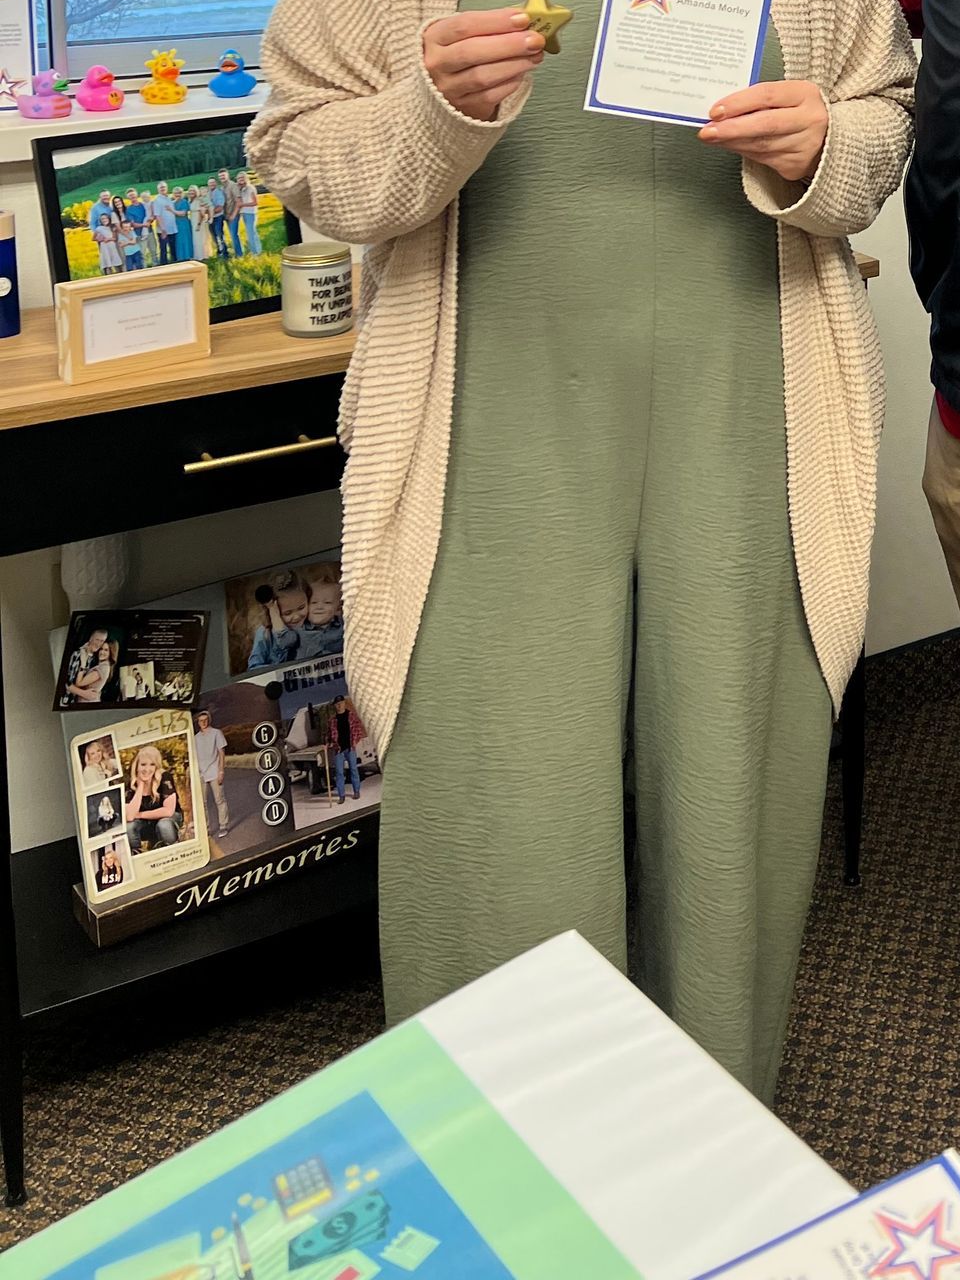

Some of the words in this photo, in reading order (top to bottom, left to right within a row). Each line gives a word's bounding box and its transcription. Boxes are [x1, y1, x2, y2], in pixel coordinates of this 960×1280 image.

[718, 3, 751, 18] Morley
[308, 274, 341, 287] THANK
[312, 289, 331, 300] FOR
[310, 301, 326, 312] MY
[283, 664, 313, 679] TREVIN
[174, 829, 361, 917] Memories
